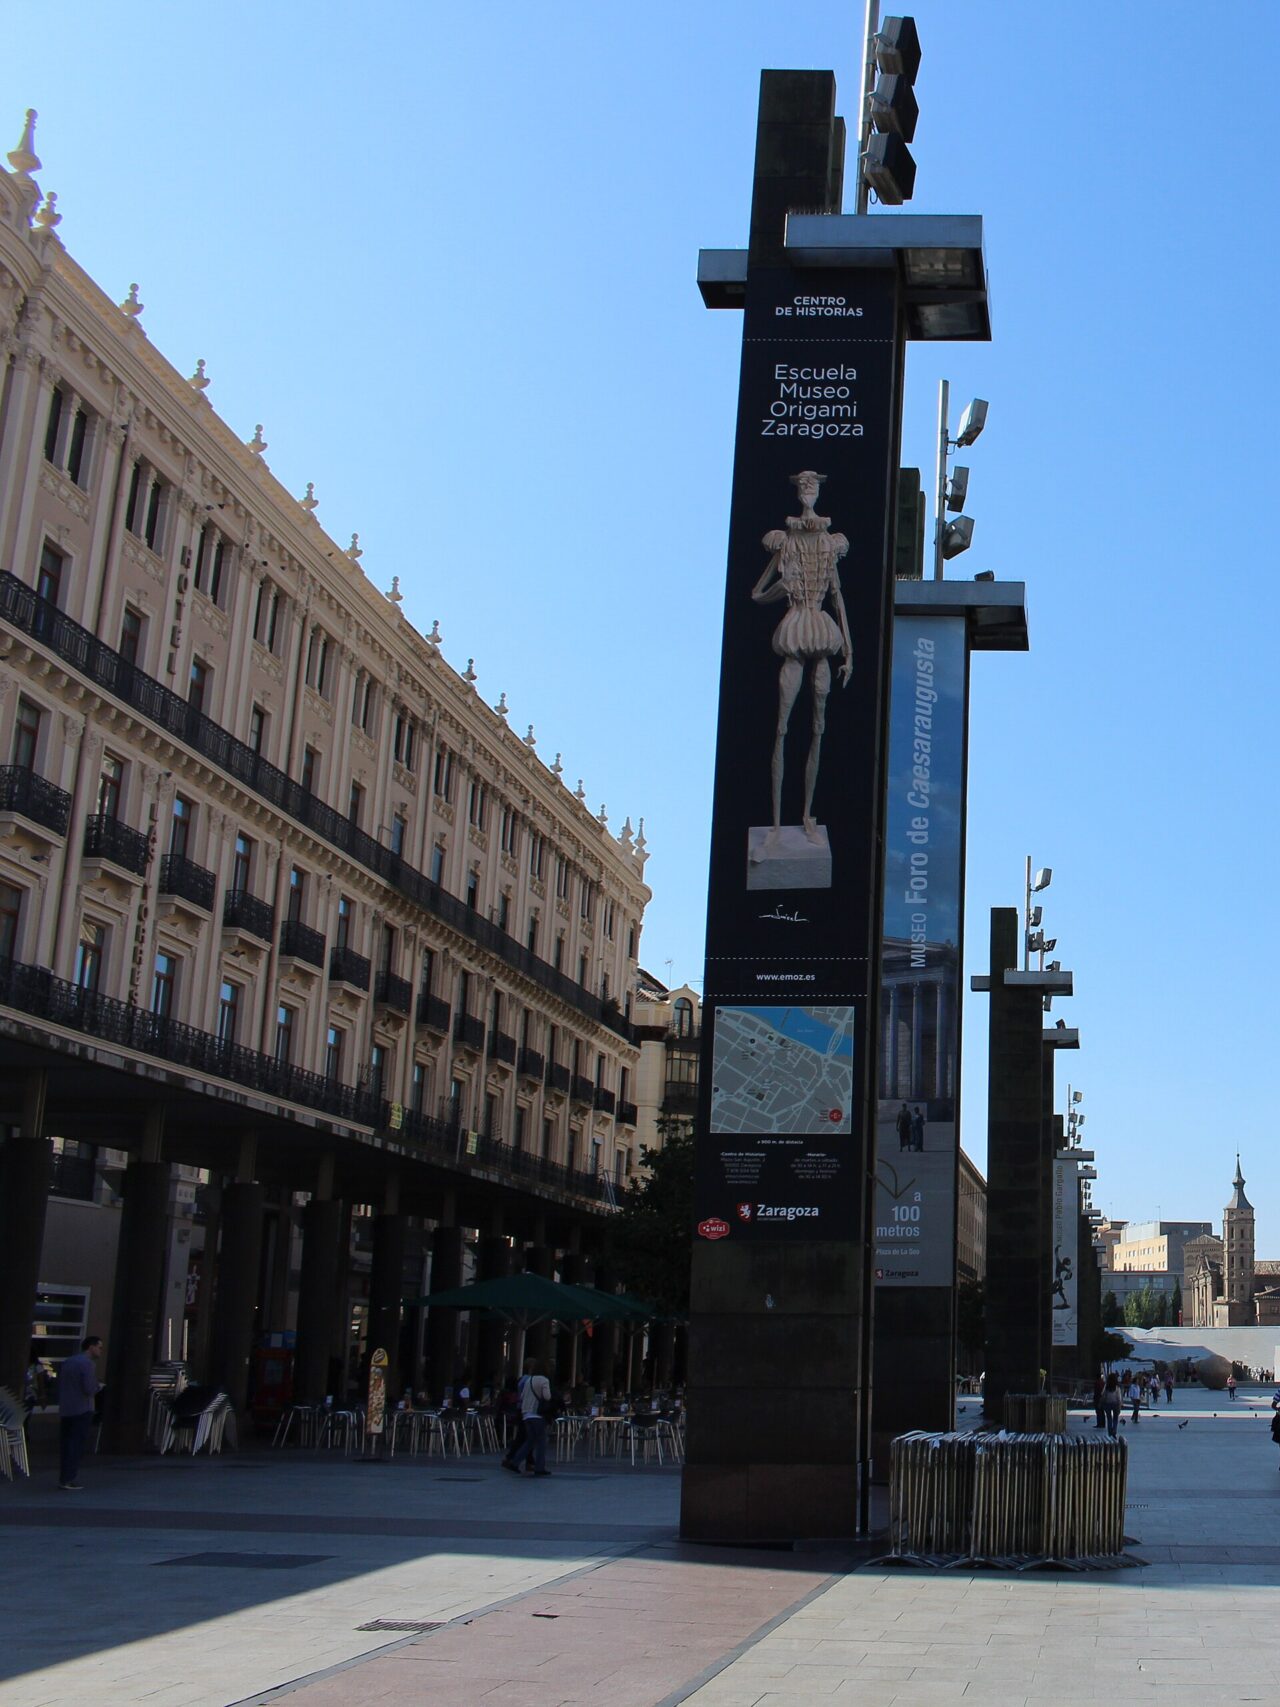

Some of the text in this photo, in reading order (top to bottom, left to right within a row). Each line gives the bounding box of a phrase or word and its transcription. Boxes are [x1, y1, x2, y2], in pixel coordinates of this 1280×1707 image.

[793, 296, 846, 306] CENTRO
[775, 307, 863, 317] DE HISTORIAS
[775, 364, 857, 380] Escuela
[780, 383, 850, 399] Museo
[770, 401, 857, 420] Origami
[761, 420, 864, 439] Zaragoza
[905, 637, 937, 967] MUSEO Foro de Caesaraugusta
[756, 973, 816, 982] www.emoz.es
[1055, 1166, 1064, 1196] Gargallo
[913, 1192, 922, 1202] a
[757, 1204, 820, 1221] Zaragoza
[891, 1205, 921, 1222] 100
[1055, 1199, 1063, 1219] Pablo
[876, 1225, 920, 1237] metros
[885, 1270, 919, 1278] Zaragoza
